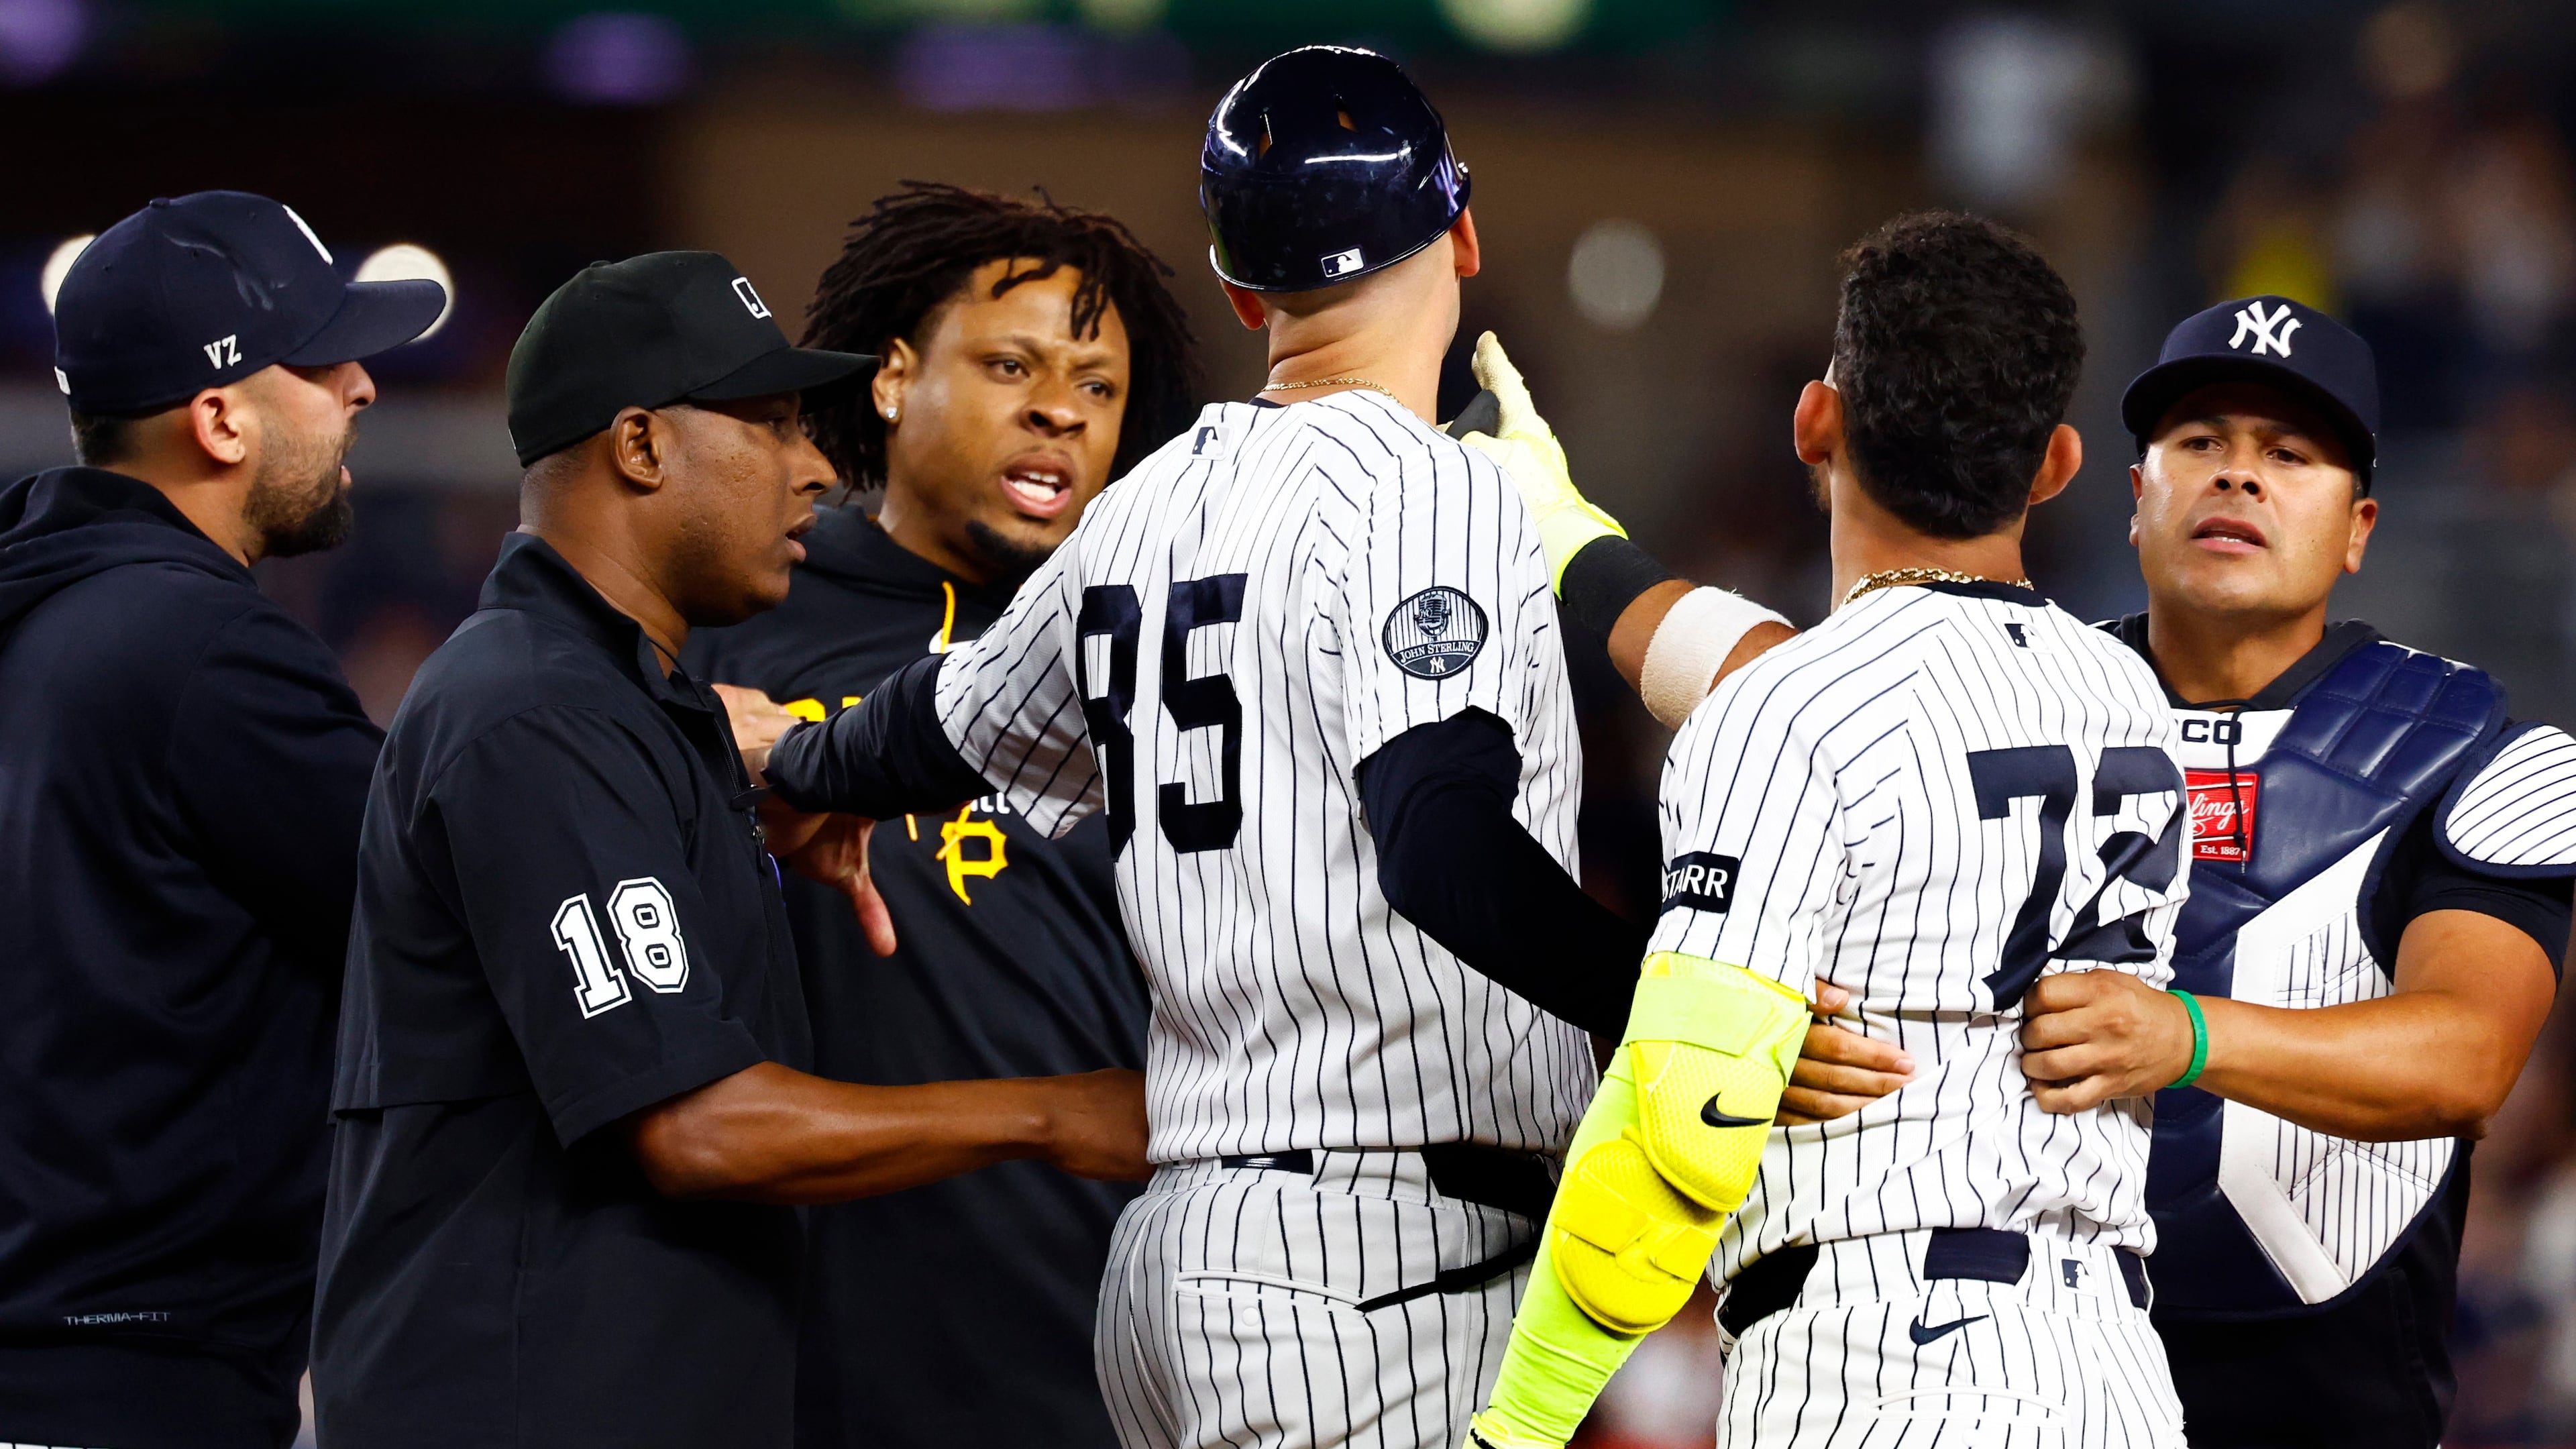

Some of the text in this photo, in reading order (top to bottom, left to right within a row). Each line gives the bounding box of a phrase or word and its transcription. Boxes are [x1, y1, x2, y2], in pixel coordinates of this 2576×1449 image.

[2228, 301, 2303, 358] NY
[203, 334, 241, 370] VZ
[1400, 642, 1474, 663] JOHN STERLING
[1430, 656, 1446, 673] NY
[1076, 573, 1248, 863] 85
[2174, 718, 2242, 745] CO
[2200, 845, 2241, 855] Est. 1887
[1966, 745, 2186, 1012] 72
[550, 876, 690, 1020] 18
[63, 1311, 170, 1326] THERMA-FIT
